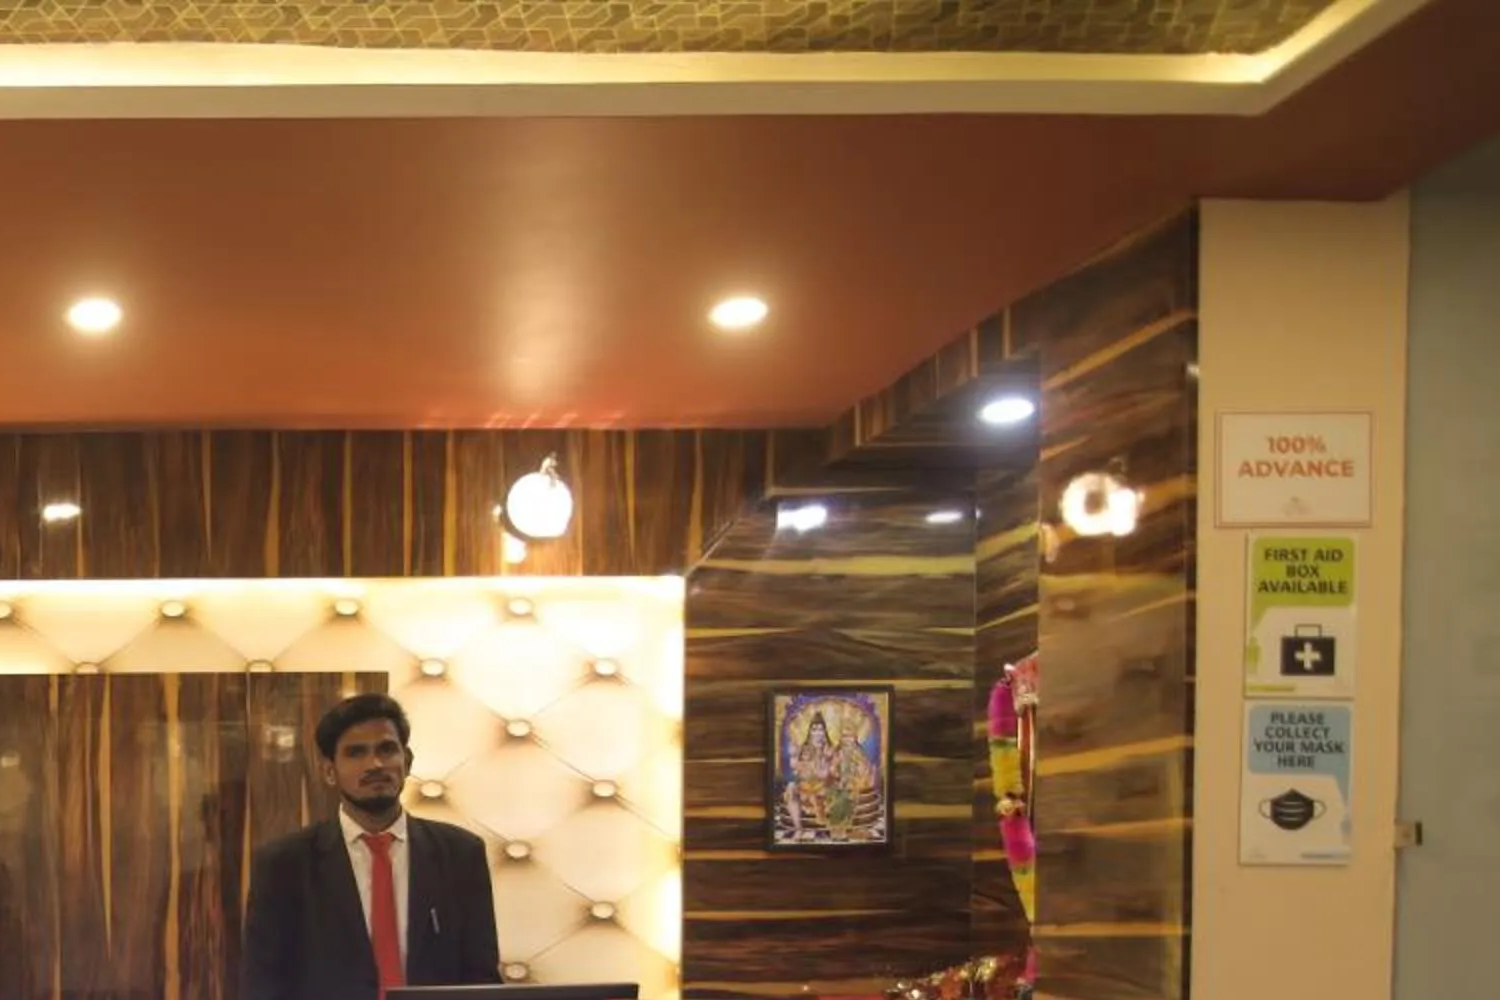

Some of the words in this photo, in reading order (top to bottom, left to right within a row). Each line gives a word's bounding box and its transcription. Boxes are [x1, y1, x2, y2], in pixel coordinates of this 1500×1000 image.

[1266, 435, 1328, 454] 100%
[1238, 460, 1355, 478] ADVANCE
[1264, 548, 1308, 562] FIRST
[1313, 548, 1344, 562] AID
[1285, 564, 1320, 579] BOX
[1257, 580, 1348, 595] AVAILABLE
[1270, 712, 1326, 726] PLEASE
[1264, 726, 1332, 740] COLLECT
[1253, 740, 1296, 753] YOUR
[1299, 740, 1346, 754] MASK
[1276, 755, 1316, 769] HERE
